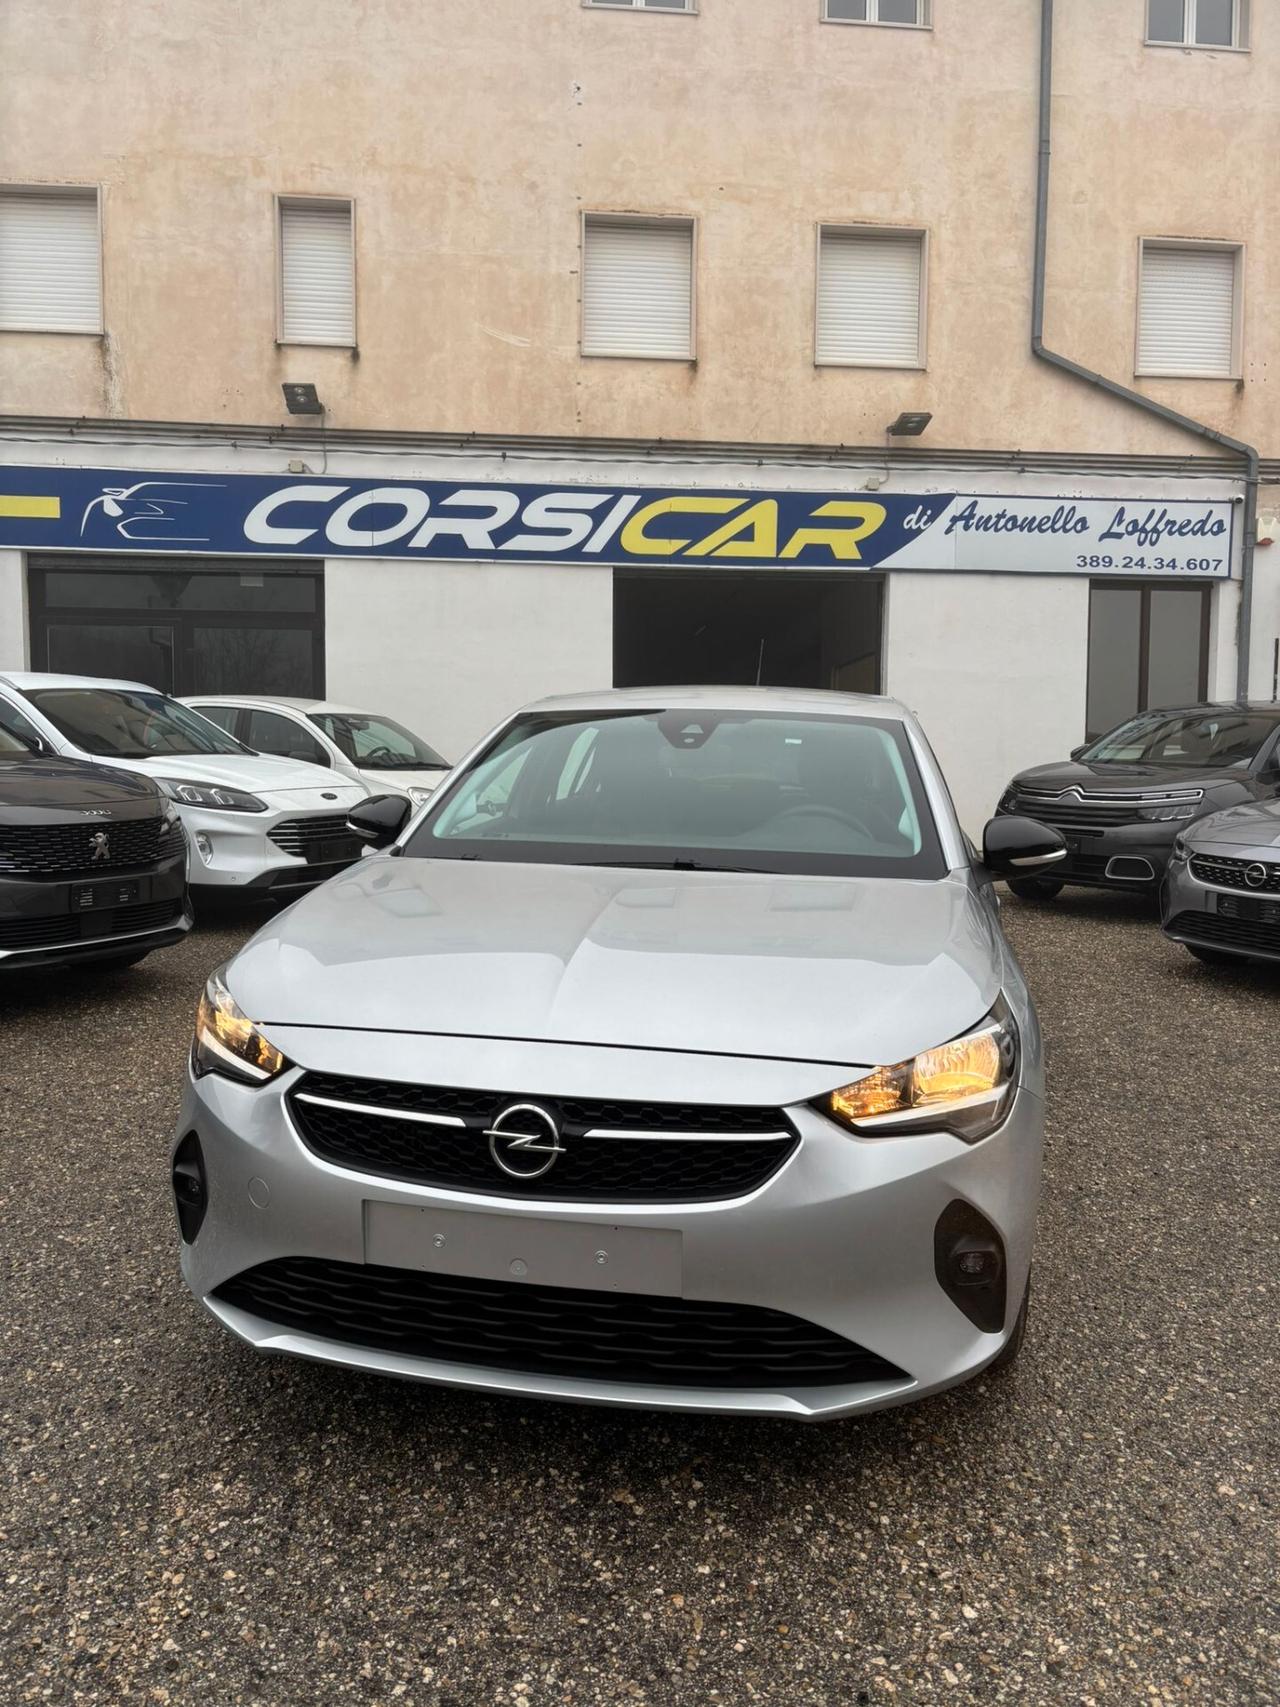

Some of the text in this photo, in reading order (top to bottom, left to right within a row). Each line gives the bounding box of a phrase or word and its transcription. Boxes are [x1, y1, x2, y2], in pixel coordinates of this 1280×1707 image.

[243, 485, 1227, 560] CORSICAR di Antonello Loffredo
[1076, 555, 1224, 572] 389.24.34.607
